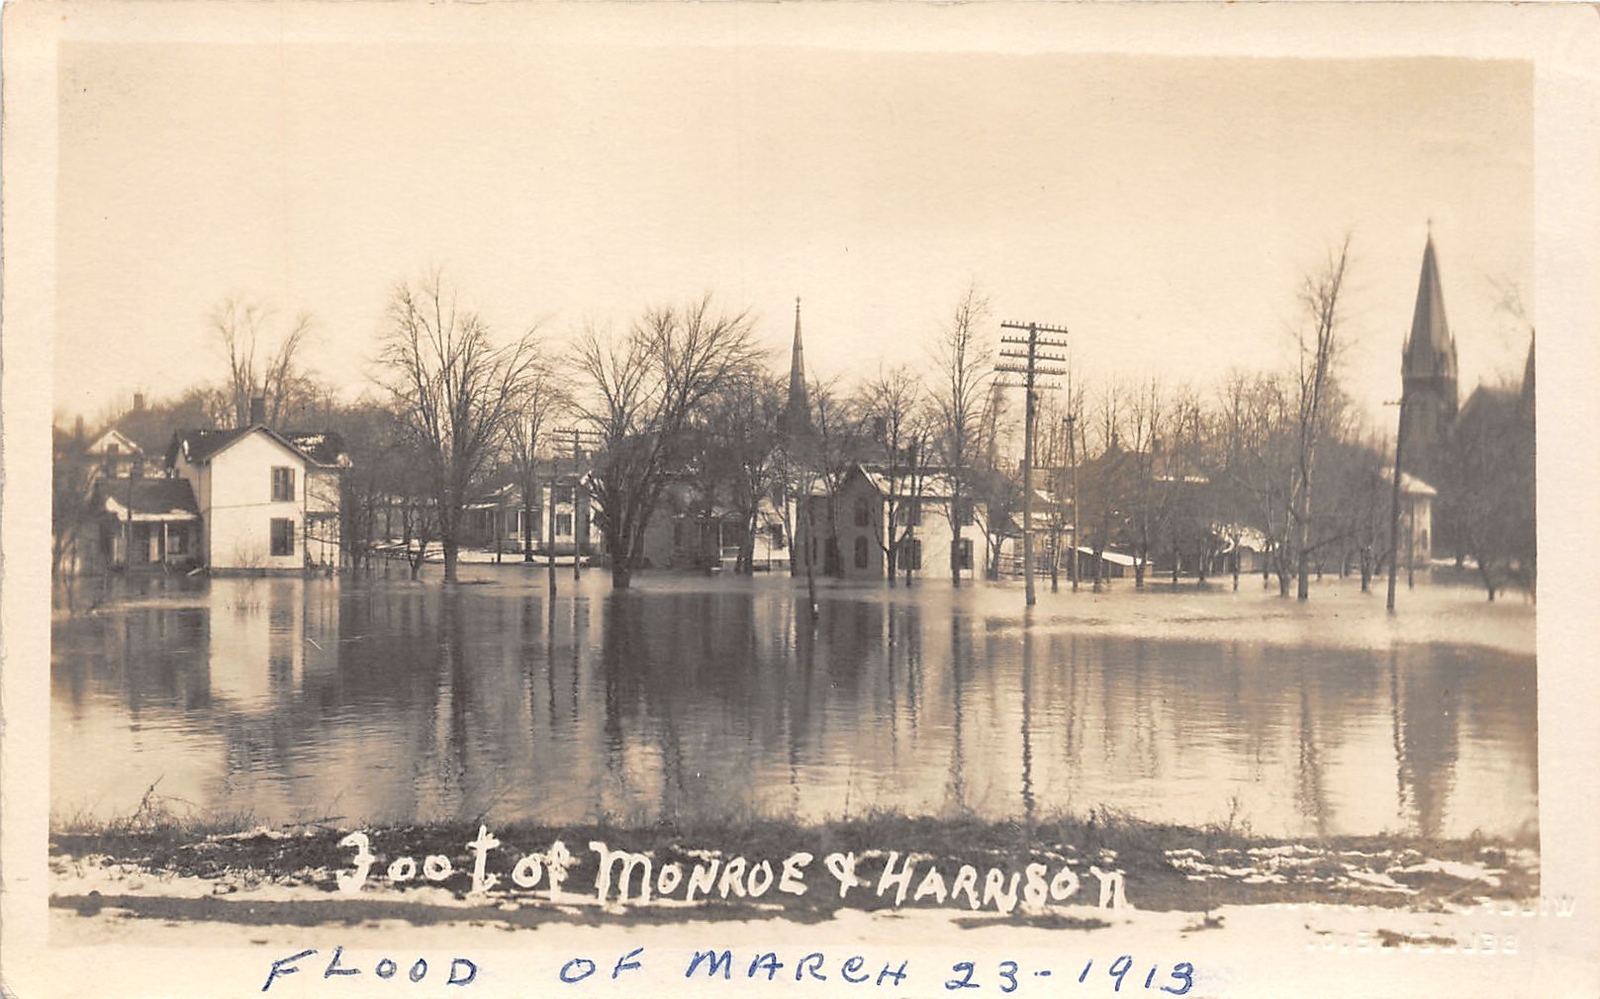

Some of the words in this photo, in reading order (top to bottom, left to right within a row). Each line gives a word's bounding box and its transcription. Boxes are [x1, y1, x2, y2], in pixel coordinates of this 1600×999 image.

[262, 946, 478, 991] FLOOD
[560, 949, 644, 984] OF
[685, 950, 907, 986] MARCH
